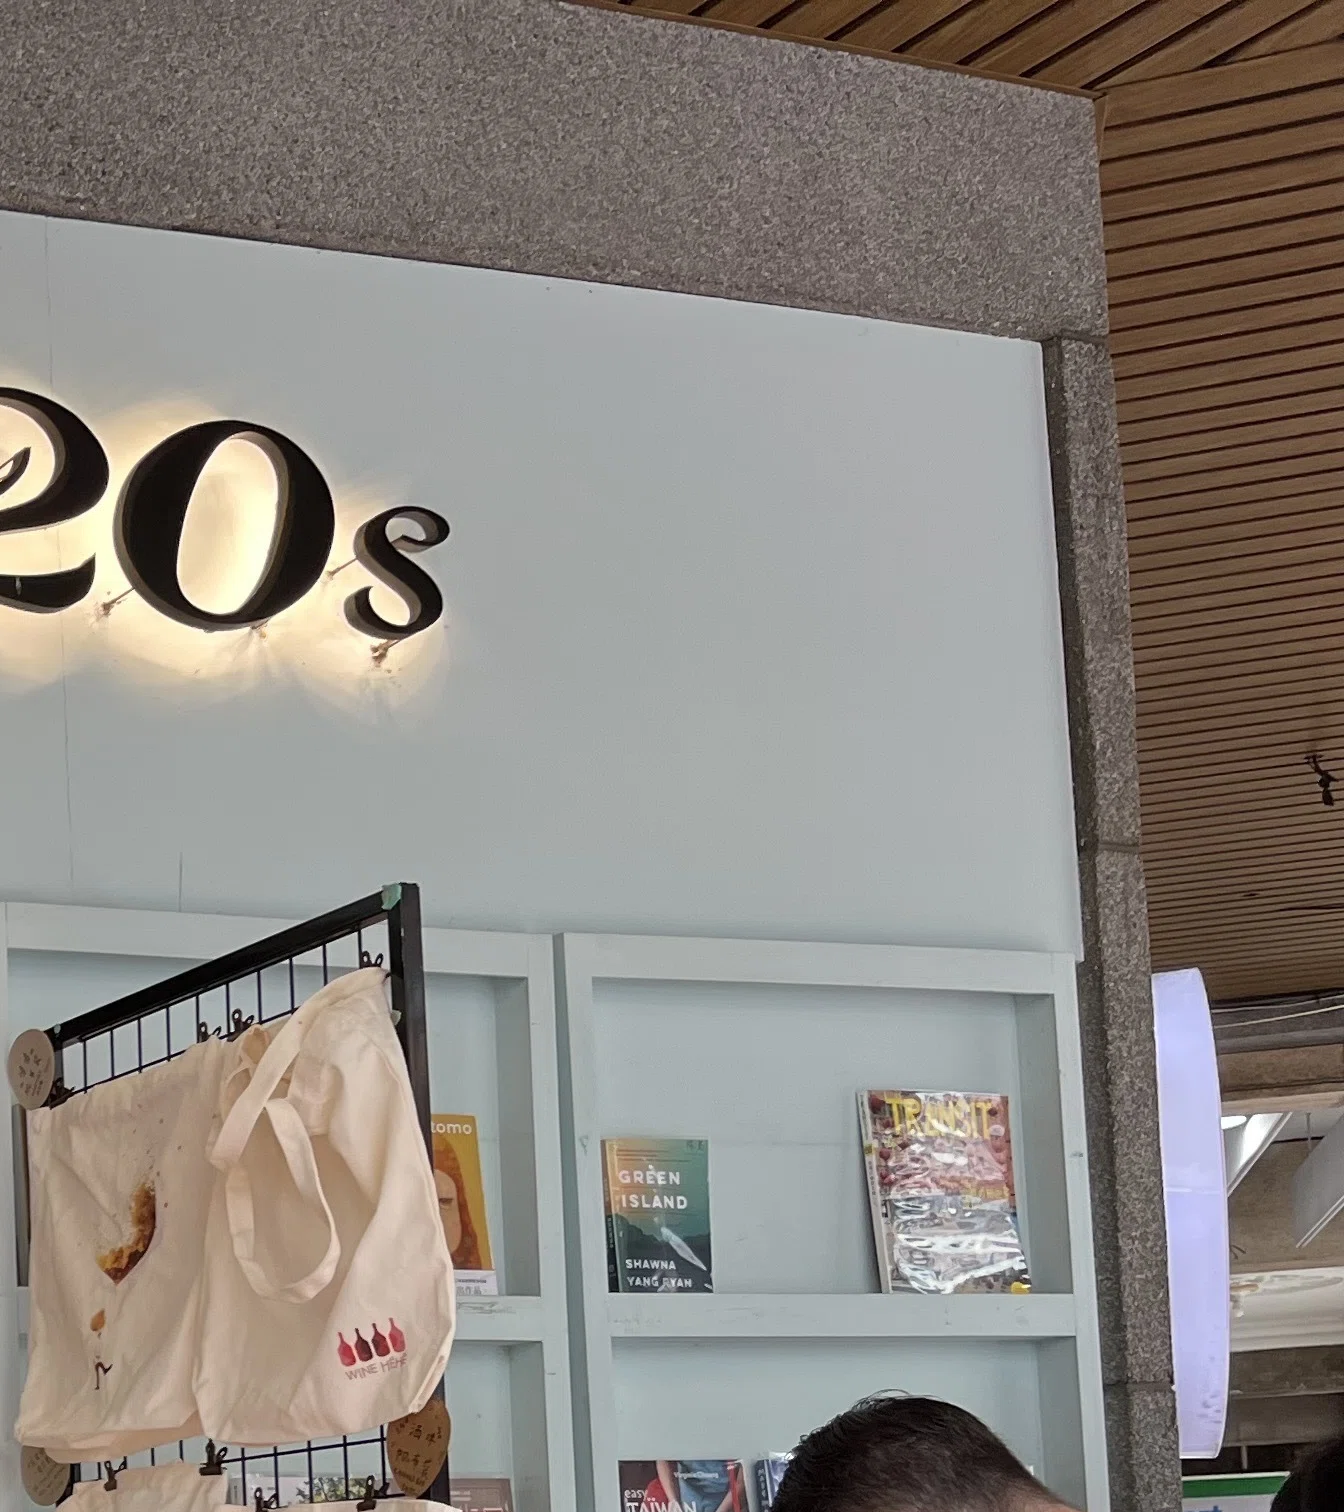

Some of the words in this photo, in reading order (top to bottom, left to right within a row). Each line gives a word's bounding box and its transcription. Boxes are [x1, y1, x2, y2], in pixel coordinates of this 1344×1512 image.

[618, 1169, 681, 1185] GREEN
[621, 1194, 688, 1210] ISLAND
[625, 1258, 677, 1270] SHAWNA
[626, 1276, 659, 1288] YANG
[344, 1362, 379, 1380] WINE
[624, 1489, 648, 1502] easy
